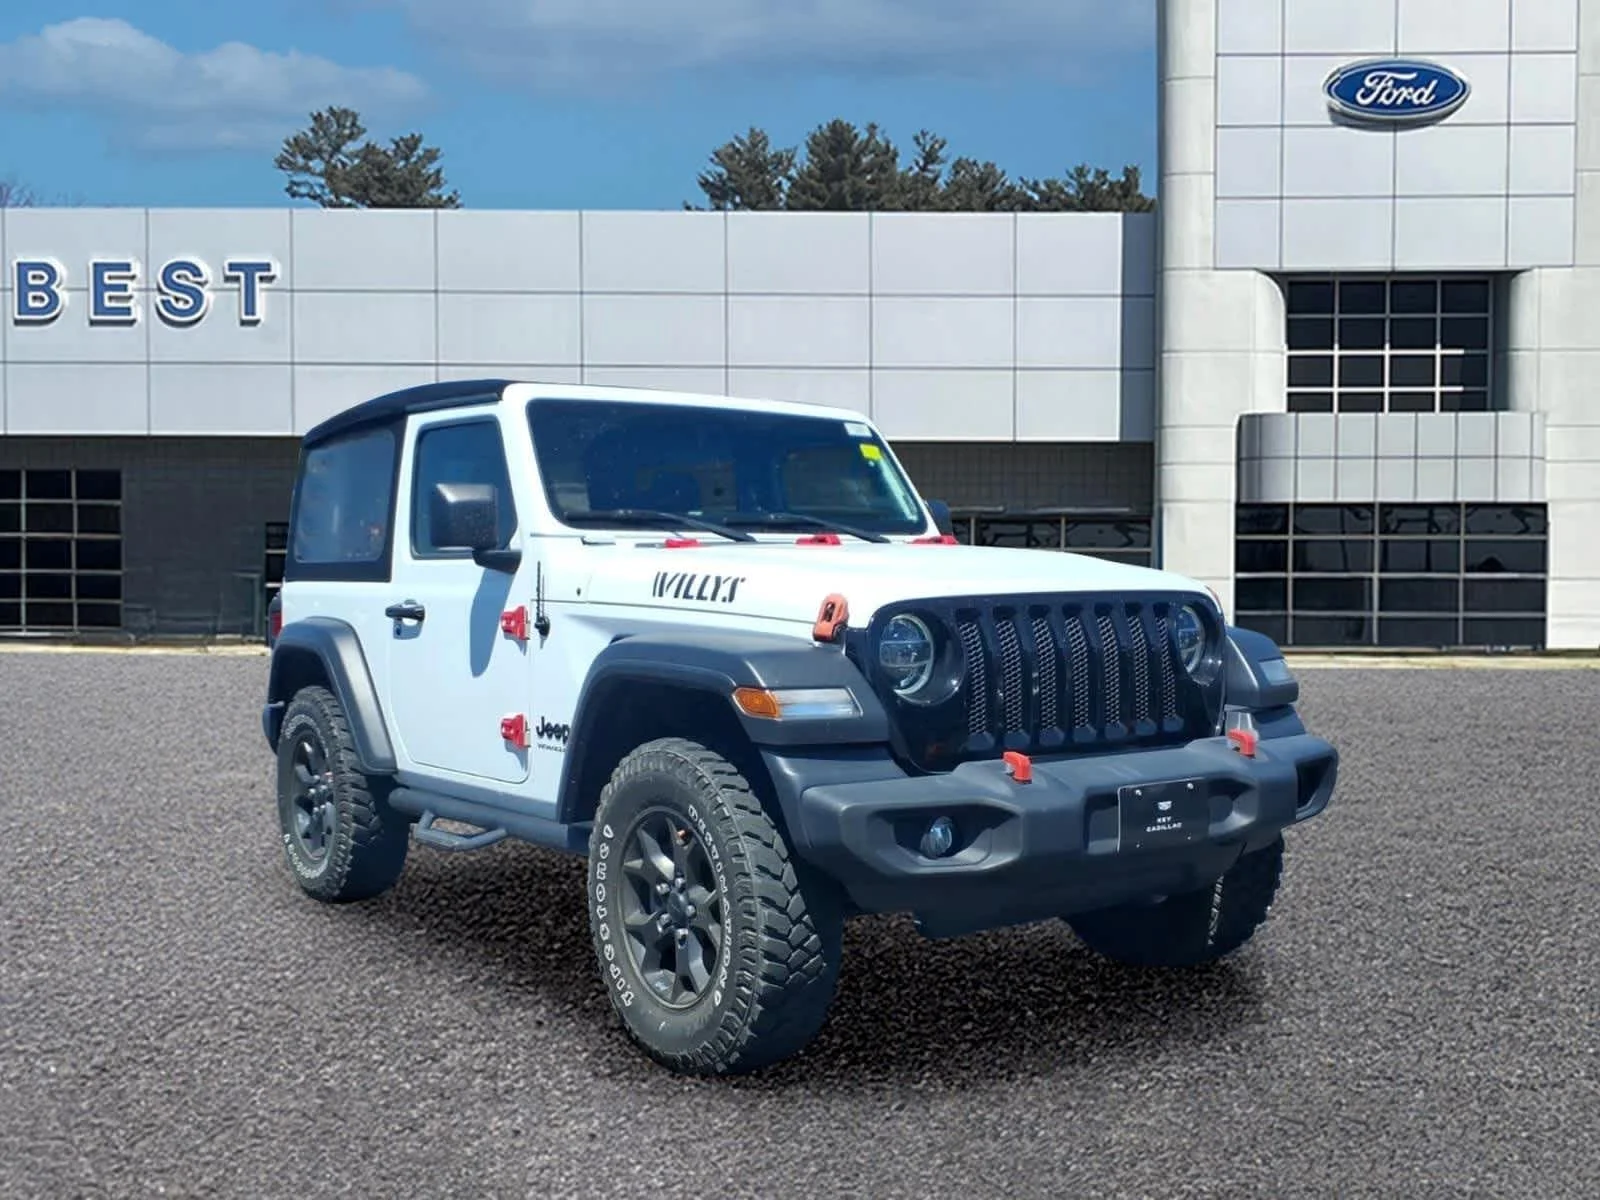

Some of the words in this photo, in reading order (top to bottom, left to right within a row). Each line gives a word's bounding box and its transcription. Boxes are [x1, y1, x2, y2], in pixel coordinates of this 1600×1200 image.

[1355, 71, 1438, 105] Ford
[14, 259, 275, 324] BEST
[652, 571, 746, 603] WILLYS
[536, 716, 570, 745] Jeep
